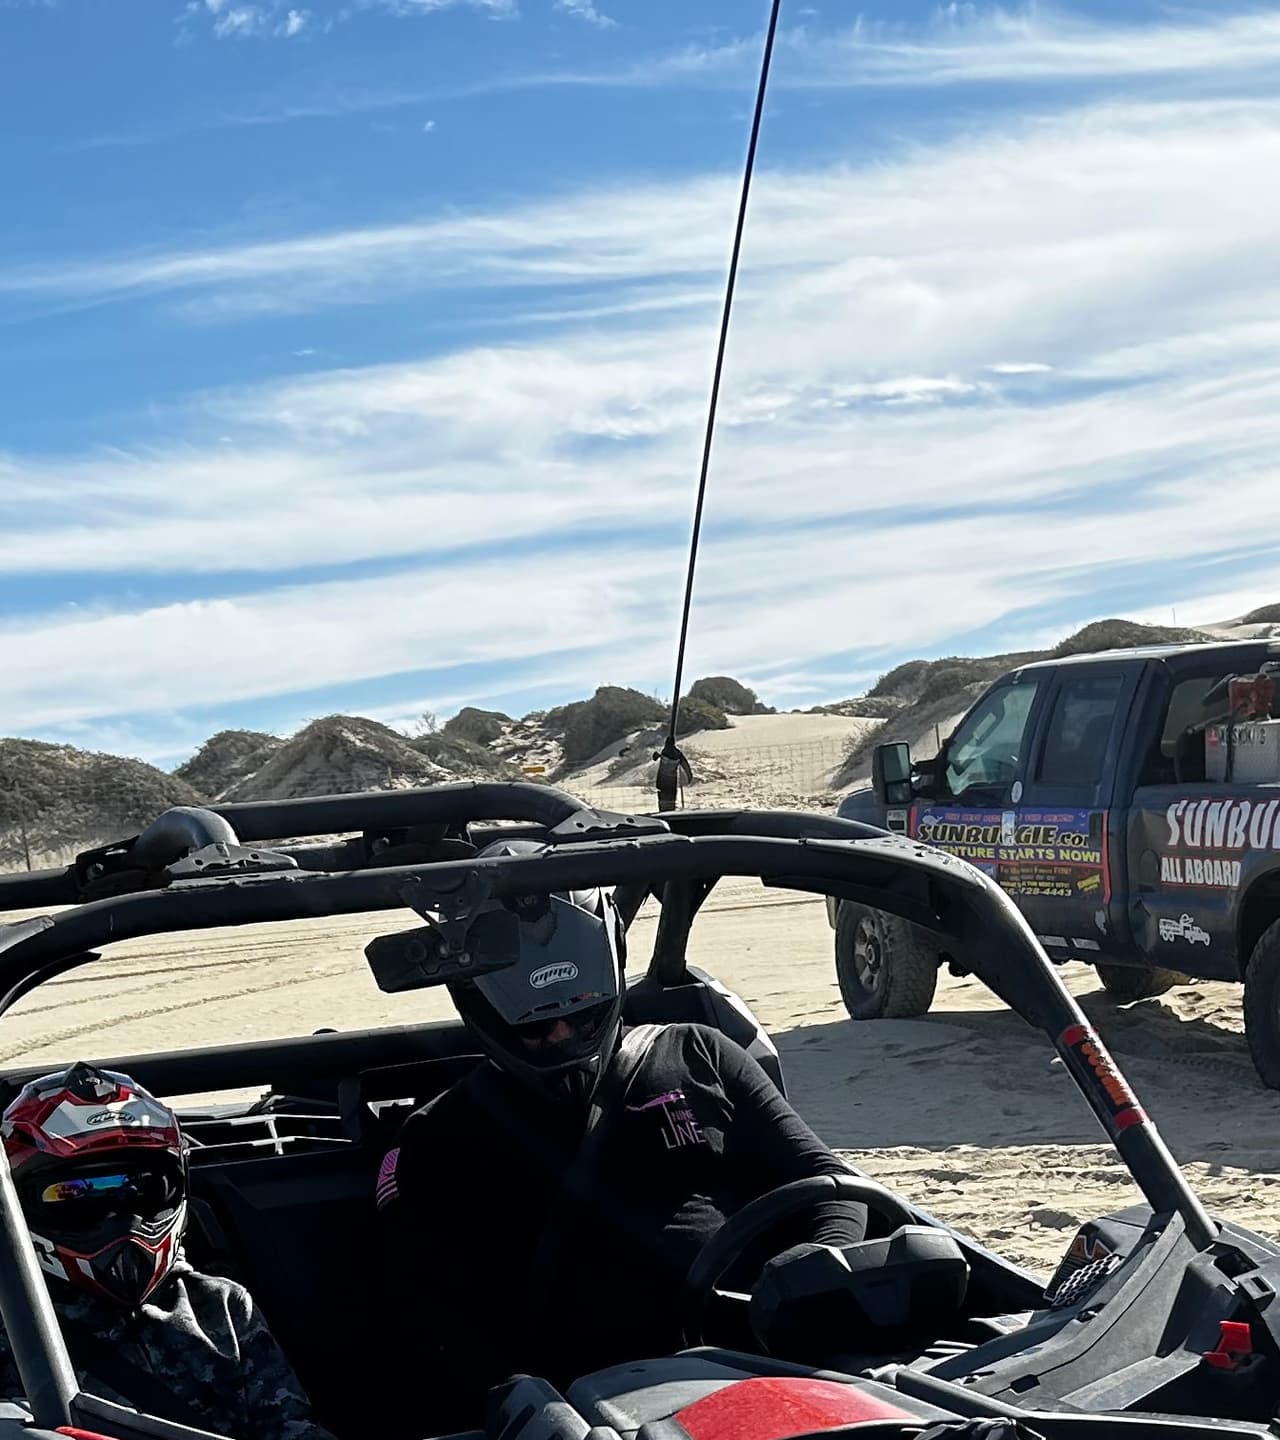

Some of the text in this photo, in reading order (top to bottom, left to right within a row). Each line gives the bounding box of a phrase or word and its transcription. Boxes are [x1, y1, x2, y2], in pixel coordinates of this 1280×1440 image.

[999, 848, 1055, 861] STARTS
[1161, 857, 1242, 887] ALL ABOARD
[661, 1110, 707, 1149] LINE
